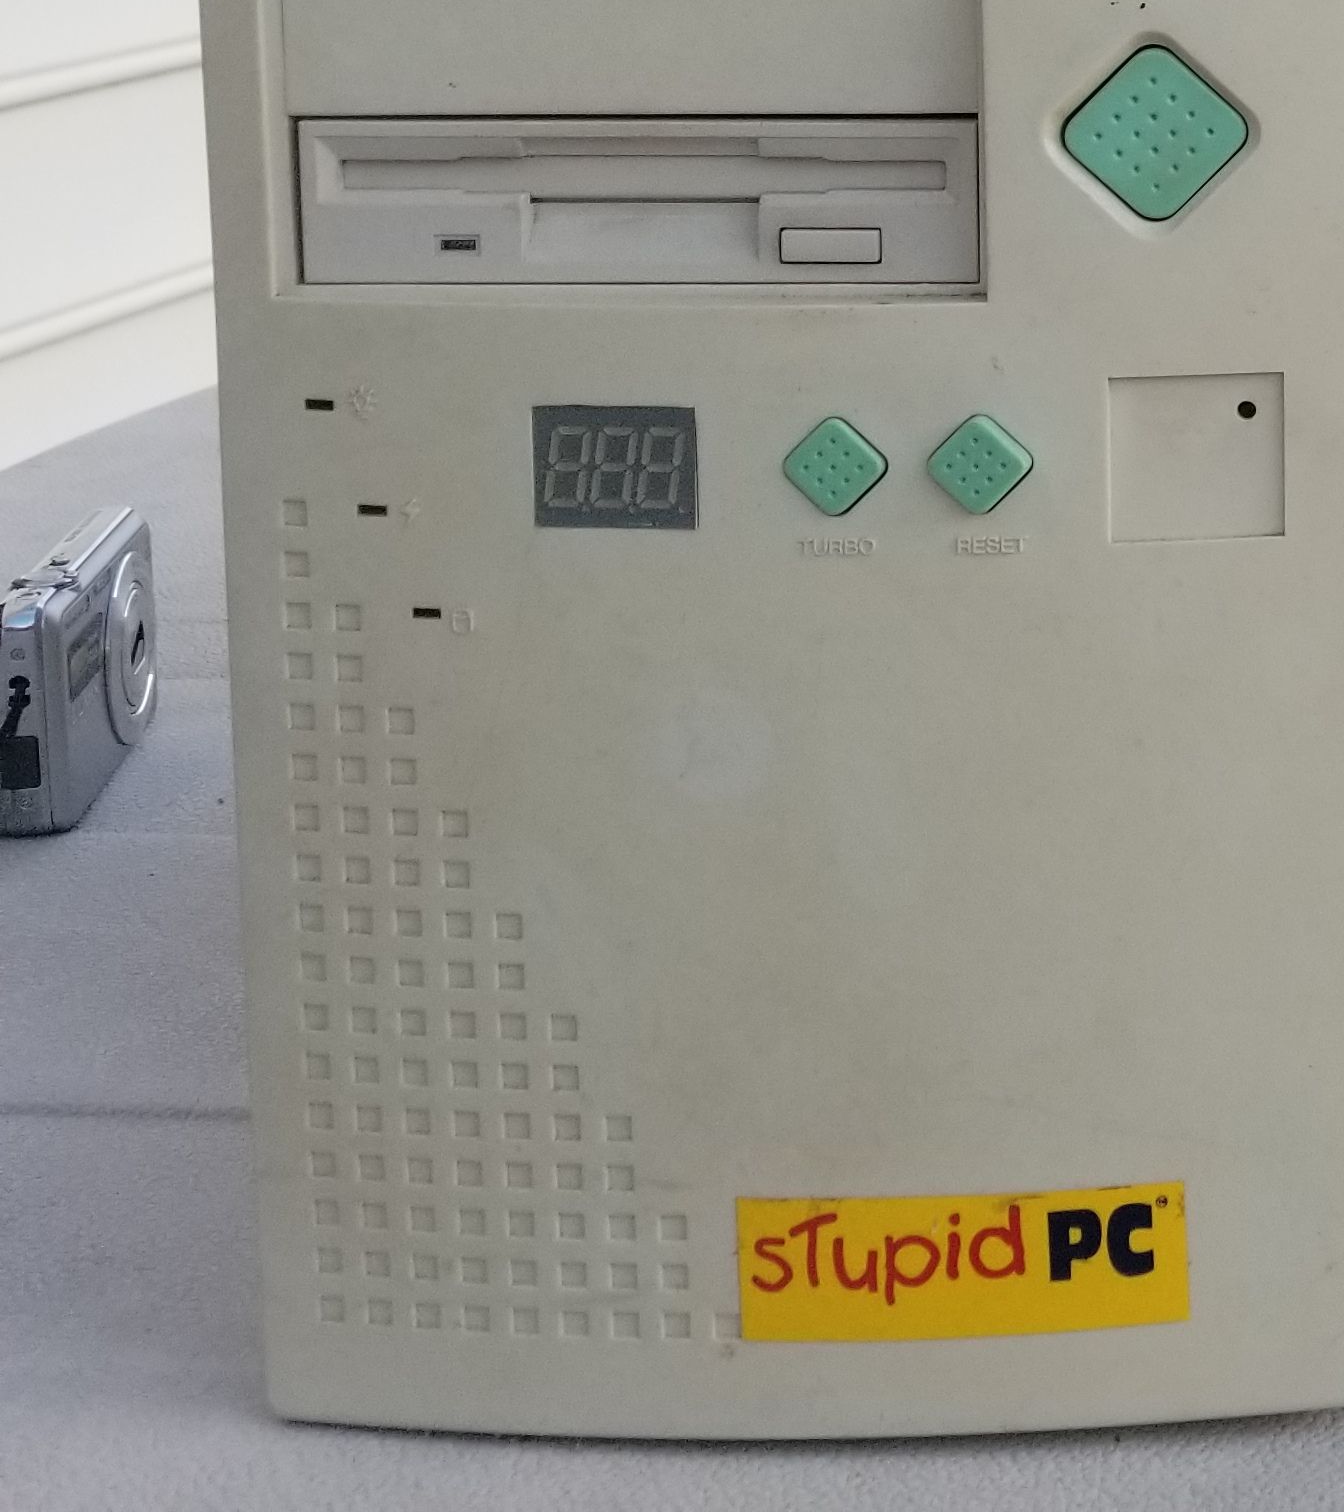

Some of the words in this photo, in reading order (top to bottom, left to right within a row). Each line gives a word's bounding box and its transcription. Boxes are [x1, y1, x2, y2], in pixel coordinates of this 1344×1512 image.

[797, 536, 878, 557] TURBO
[955, 535, 1028, 555] RESET
[752, 1204, 1026, 1306] sTupid
[1047, 1201, 1156, 1283] PC
